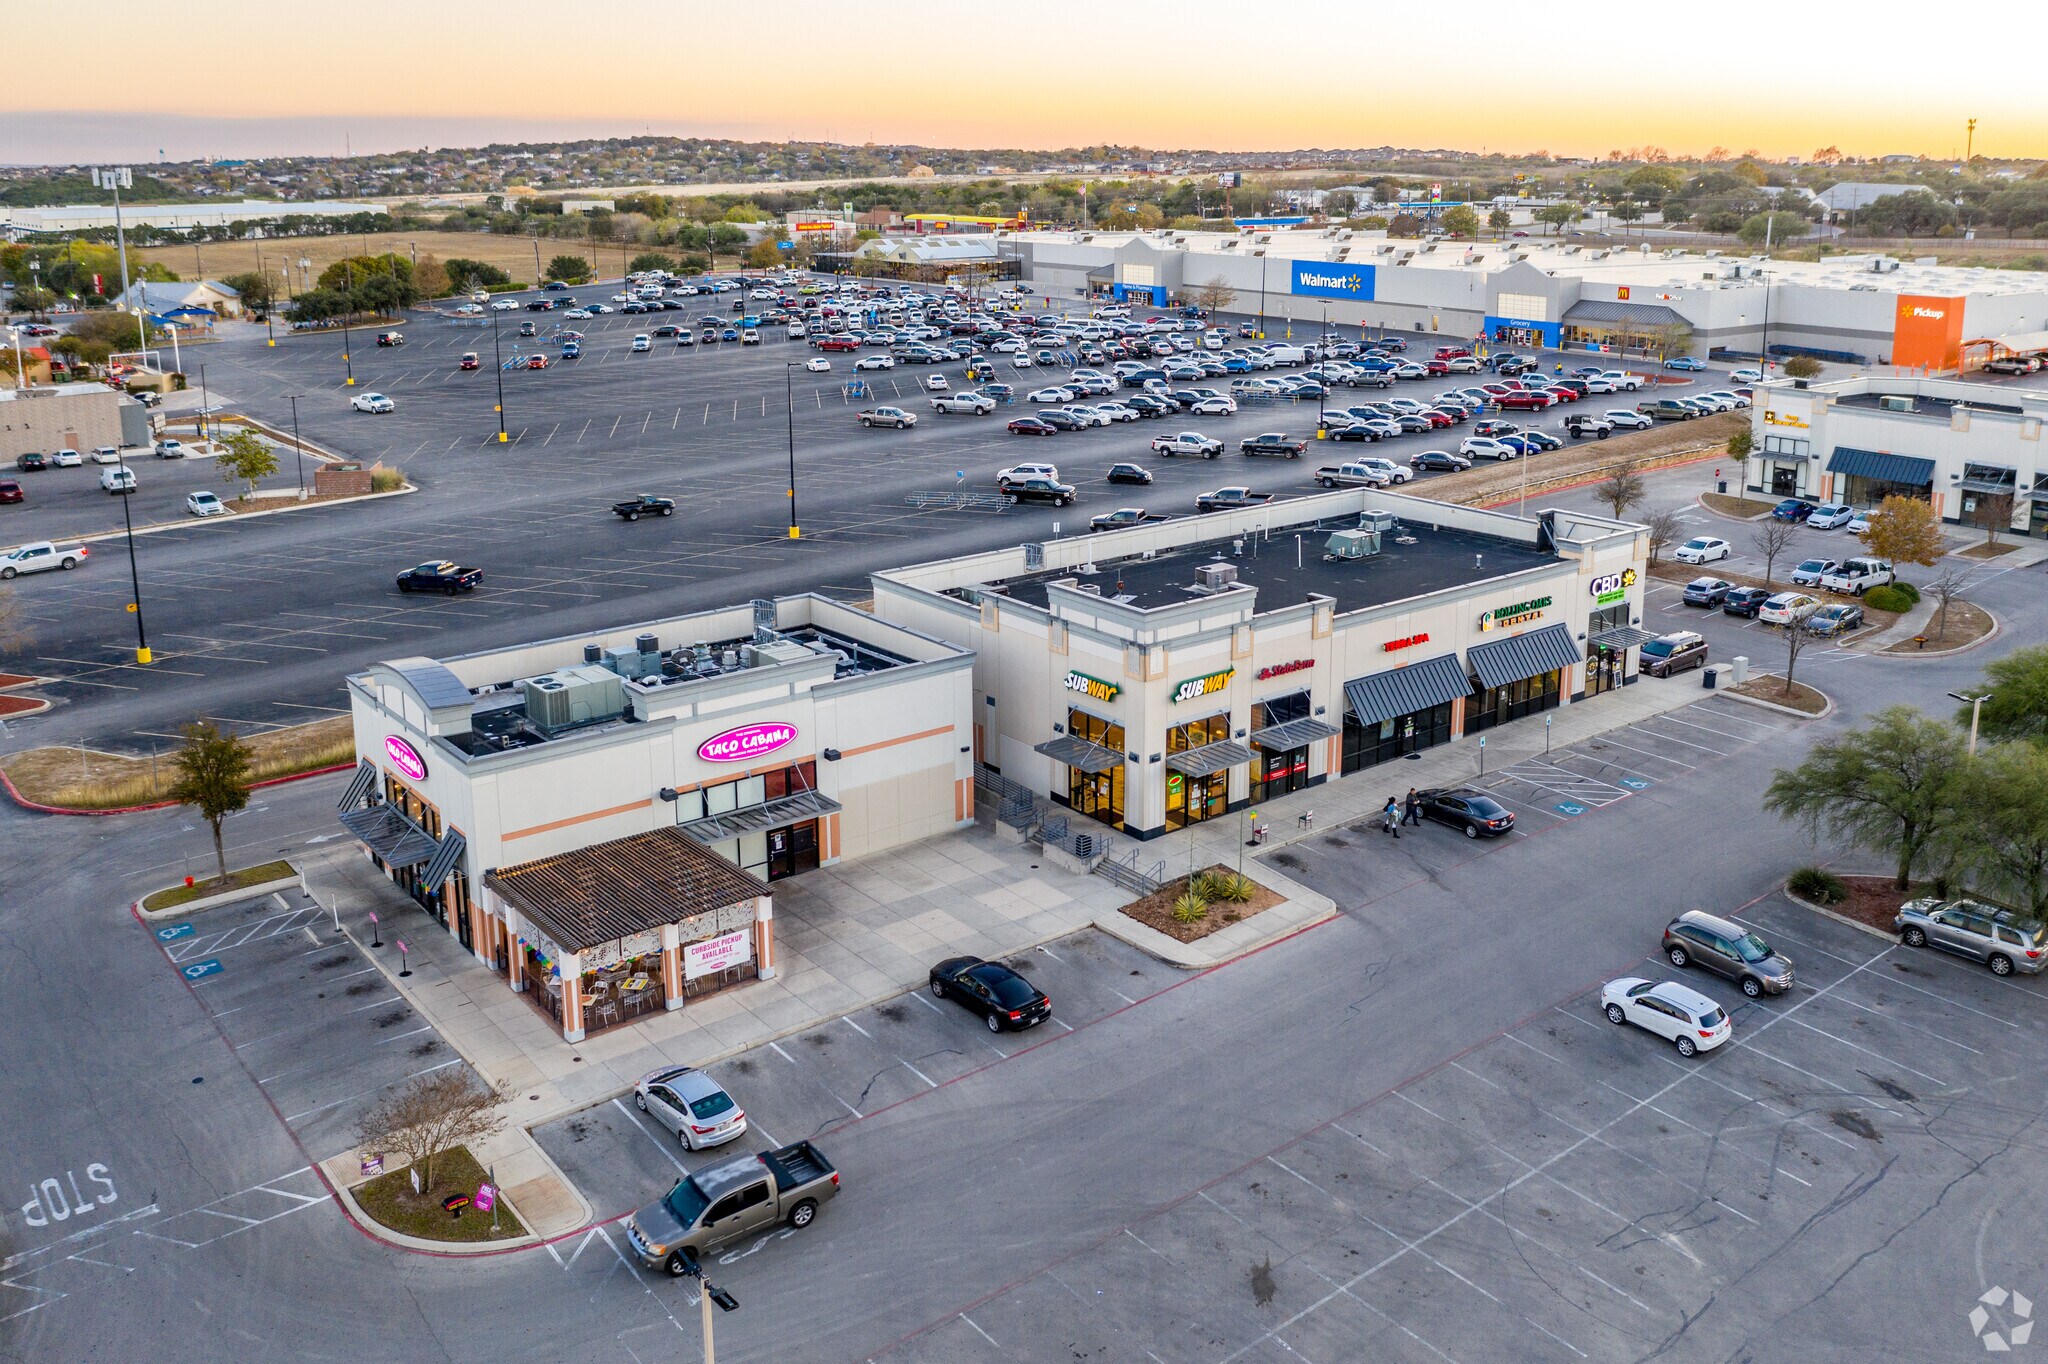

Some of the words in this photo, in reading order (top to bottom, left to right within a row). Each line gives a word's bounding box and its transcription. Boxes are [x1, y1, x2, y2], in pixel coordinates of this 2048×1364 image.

[1300, 272, 1346, 289] Walmart
[1913, 307, 1944, 320] Pickup
[1510, 319, 1531, 328] Grocery
[1591, 574, 1621, 597] CBD
[1501, 610, 1544, 627] DENTAL
[1412, 633, 1429, 645] SPA
[1064, 672, 1117, 701] SUBWAY
[1175, 669, 1237, 702] SUBWAY
[706, 739, 739, 756] TACO
[741, 728, 790, 749] CABANA
[691, 941, 720, 956] CURBSIDE
[721, 934, 743, 947] PICKUP
[701, 945, 733, 960] AVAILABLE
[22, 1162, 118, 1227] STOP
